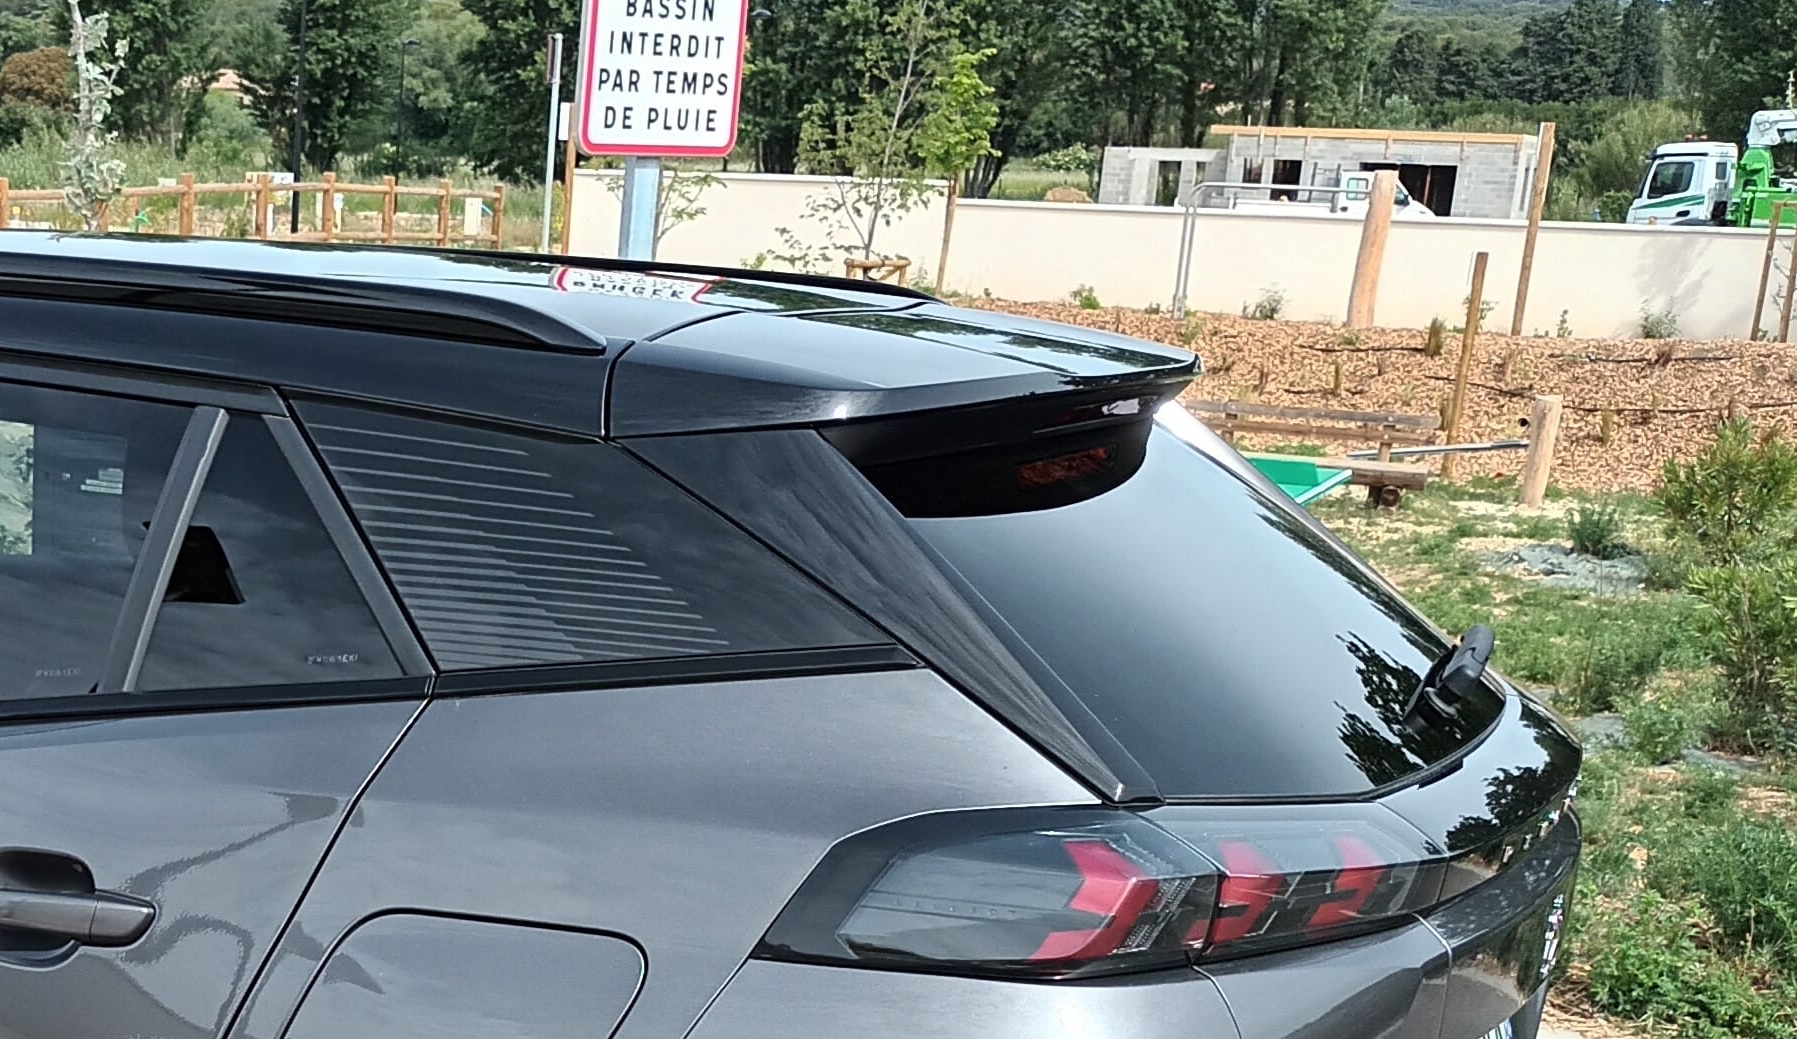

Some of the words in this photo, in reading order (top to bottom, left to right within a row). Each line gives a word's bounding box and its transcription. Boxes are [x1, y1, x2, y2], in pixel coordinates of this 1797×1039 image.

[626, 0, 715, 21] BASSIN
[609, 30, 725, 59] INTERDIT
[598, 68, 640, 93] PAR
[653, 70, 729, 96] TEMPS
[604, 106, 633, 129] DE
[647, 107, 717, 132] PLUIE
